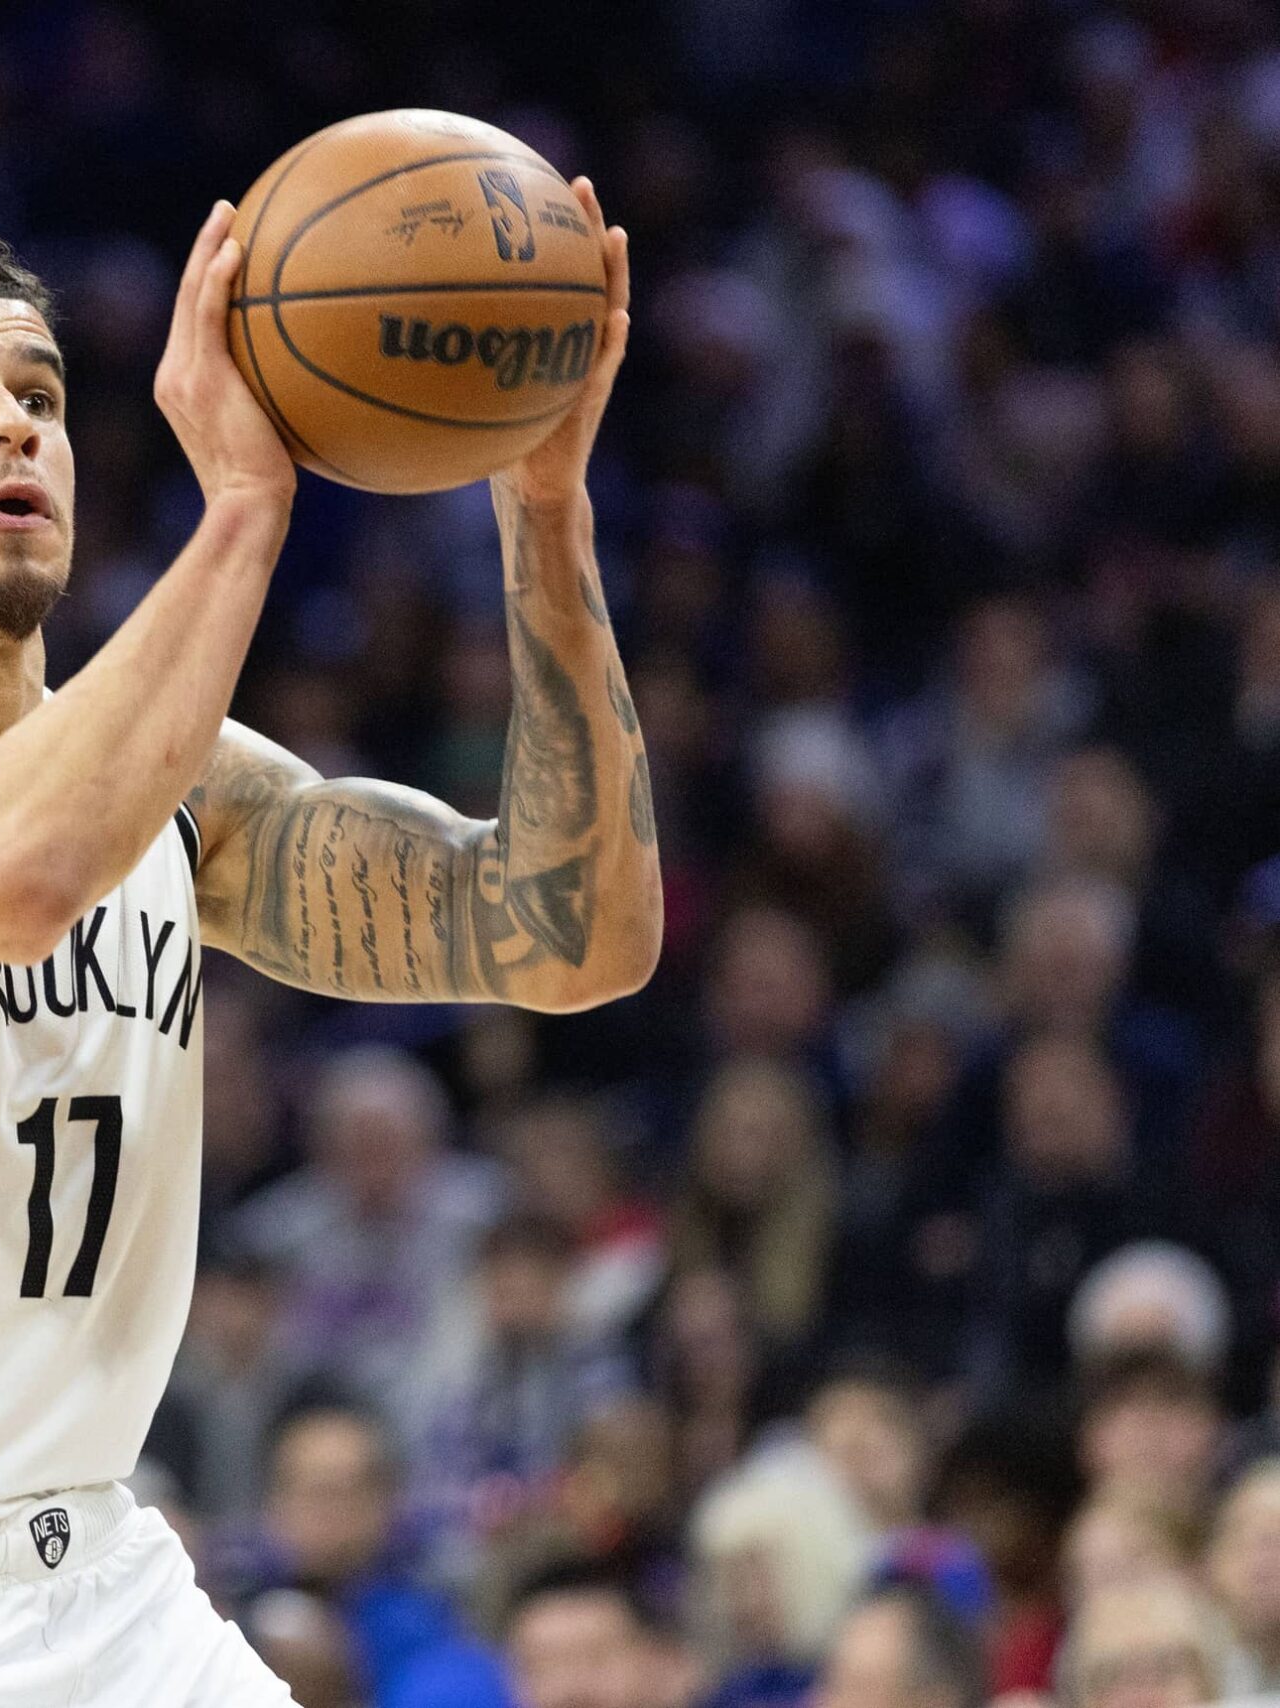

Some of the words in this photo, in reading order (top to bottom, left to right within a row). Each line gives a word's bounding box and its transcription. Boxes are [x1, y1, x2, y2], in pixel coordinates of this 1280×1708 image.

[378, 313, 595, 392] Wilson
[17, 1095, 123, 1299] 17
[33, 1511, 69, 1543] NETS
